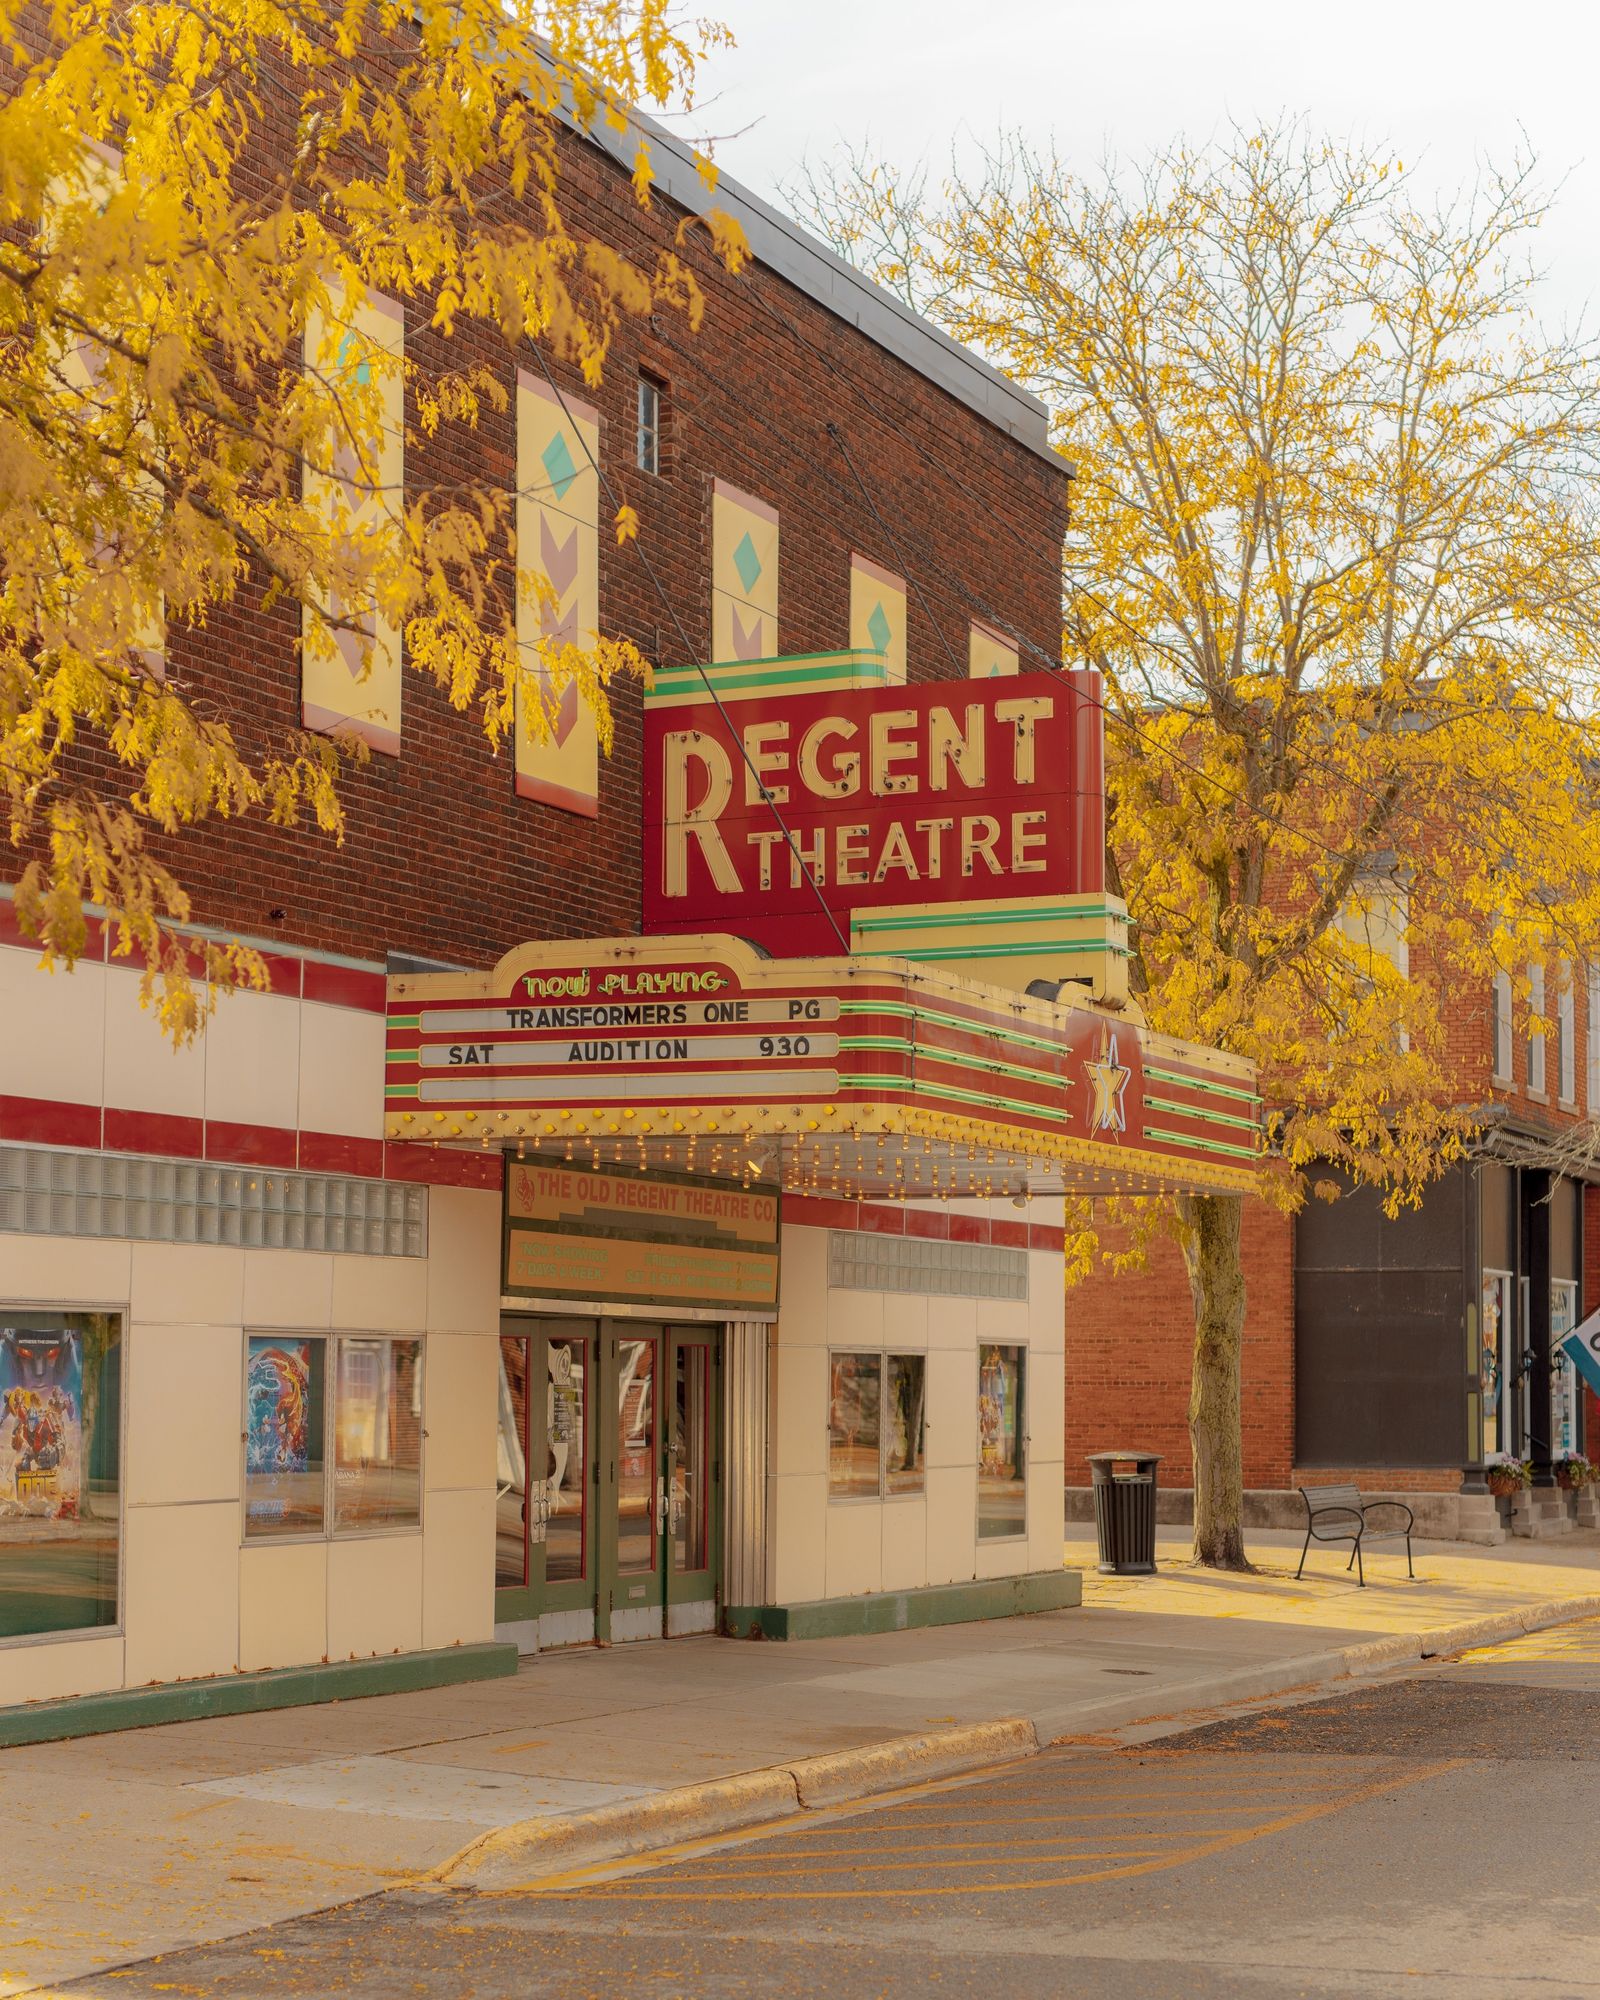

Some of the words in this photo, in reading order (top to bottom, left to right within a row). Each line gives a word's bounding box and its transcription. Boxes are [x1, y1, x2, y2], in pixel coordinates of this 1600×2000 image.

[662, 697, 1054, 897] REGENT
[747, 810, 1047, 890] THEATRE
[598, 970, 729, 996] PLAYING
[506, 1004, 687, 1029] TRANSFORMERS
[703, 1001, 749, 1023] ONE
[788, 999, 821, 1020] PG
[448, 1045, 494, 1065] SAT
[567, 1039, 688, 1062] AUDITION
[758, 1036, 811, 1057] 930
[537, 1171, 572, 1199] THE
[577, 1177, 610, 1204] OLD
[615, 1184, 680, 1212] REGENT
[684, 1190, 749, 1218] THEATRE
[753, 1199, 777, 1222] CO.
